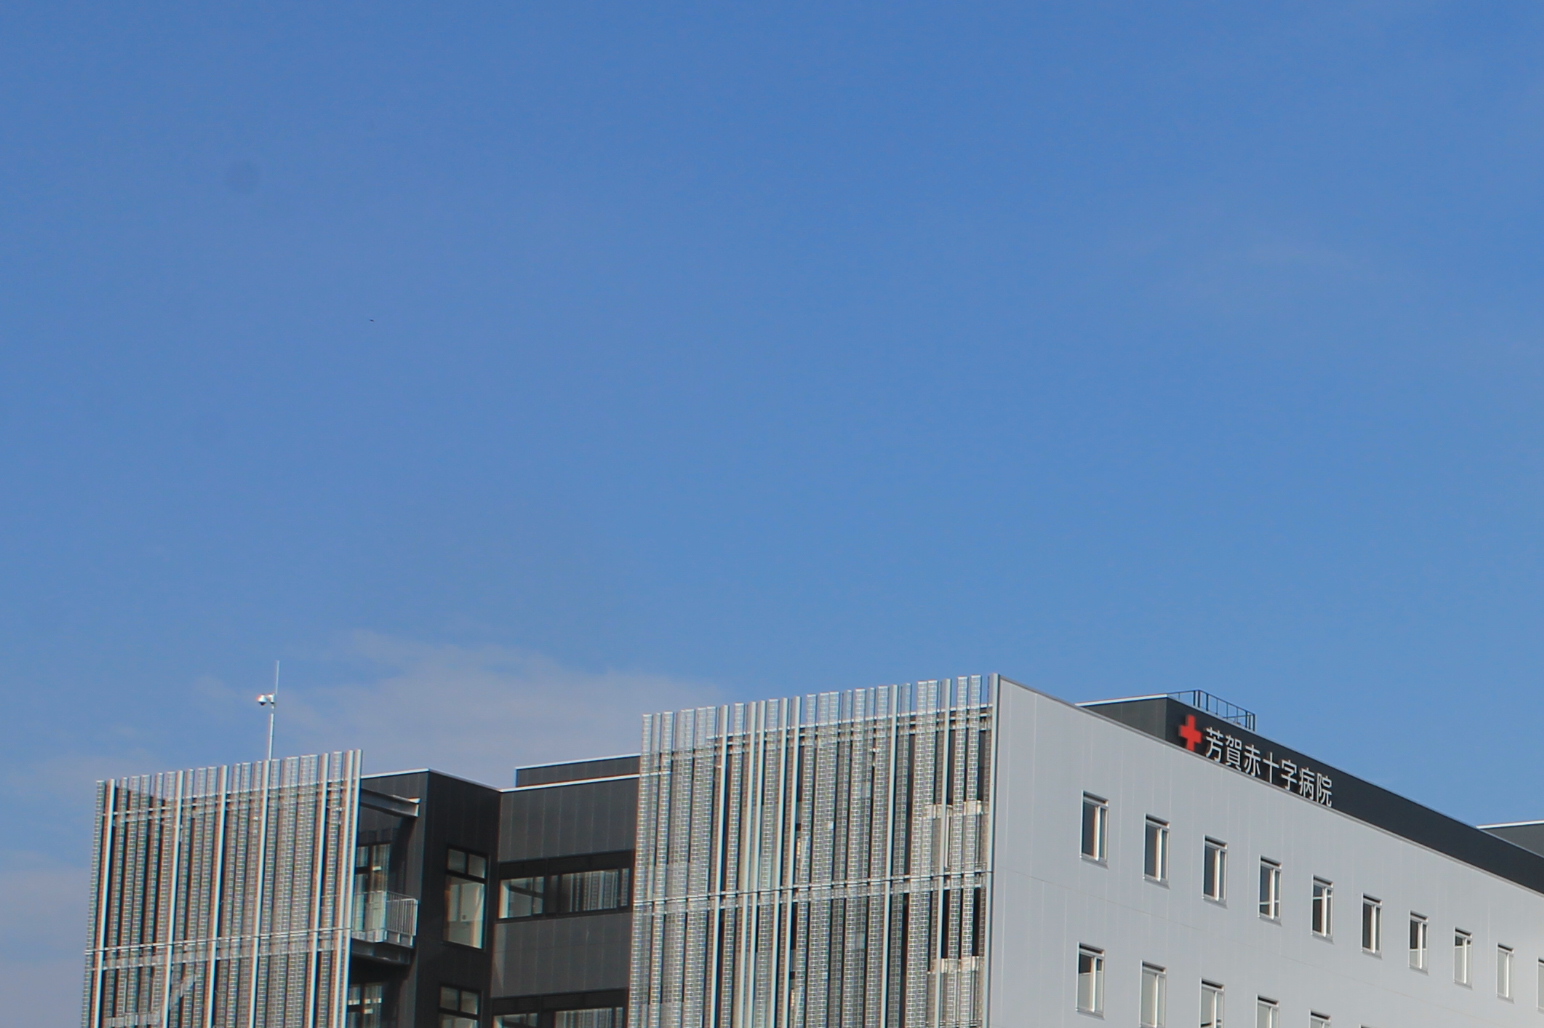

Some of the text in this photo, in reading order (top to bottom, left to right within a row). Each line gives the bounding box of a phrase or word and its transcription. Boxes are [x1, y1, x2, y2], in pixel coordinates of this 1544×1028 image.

[1205, 726, 1332, 808] 芳賀赤十字病院
